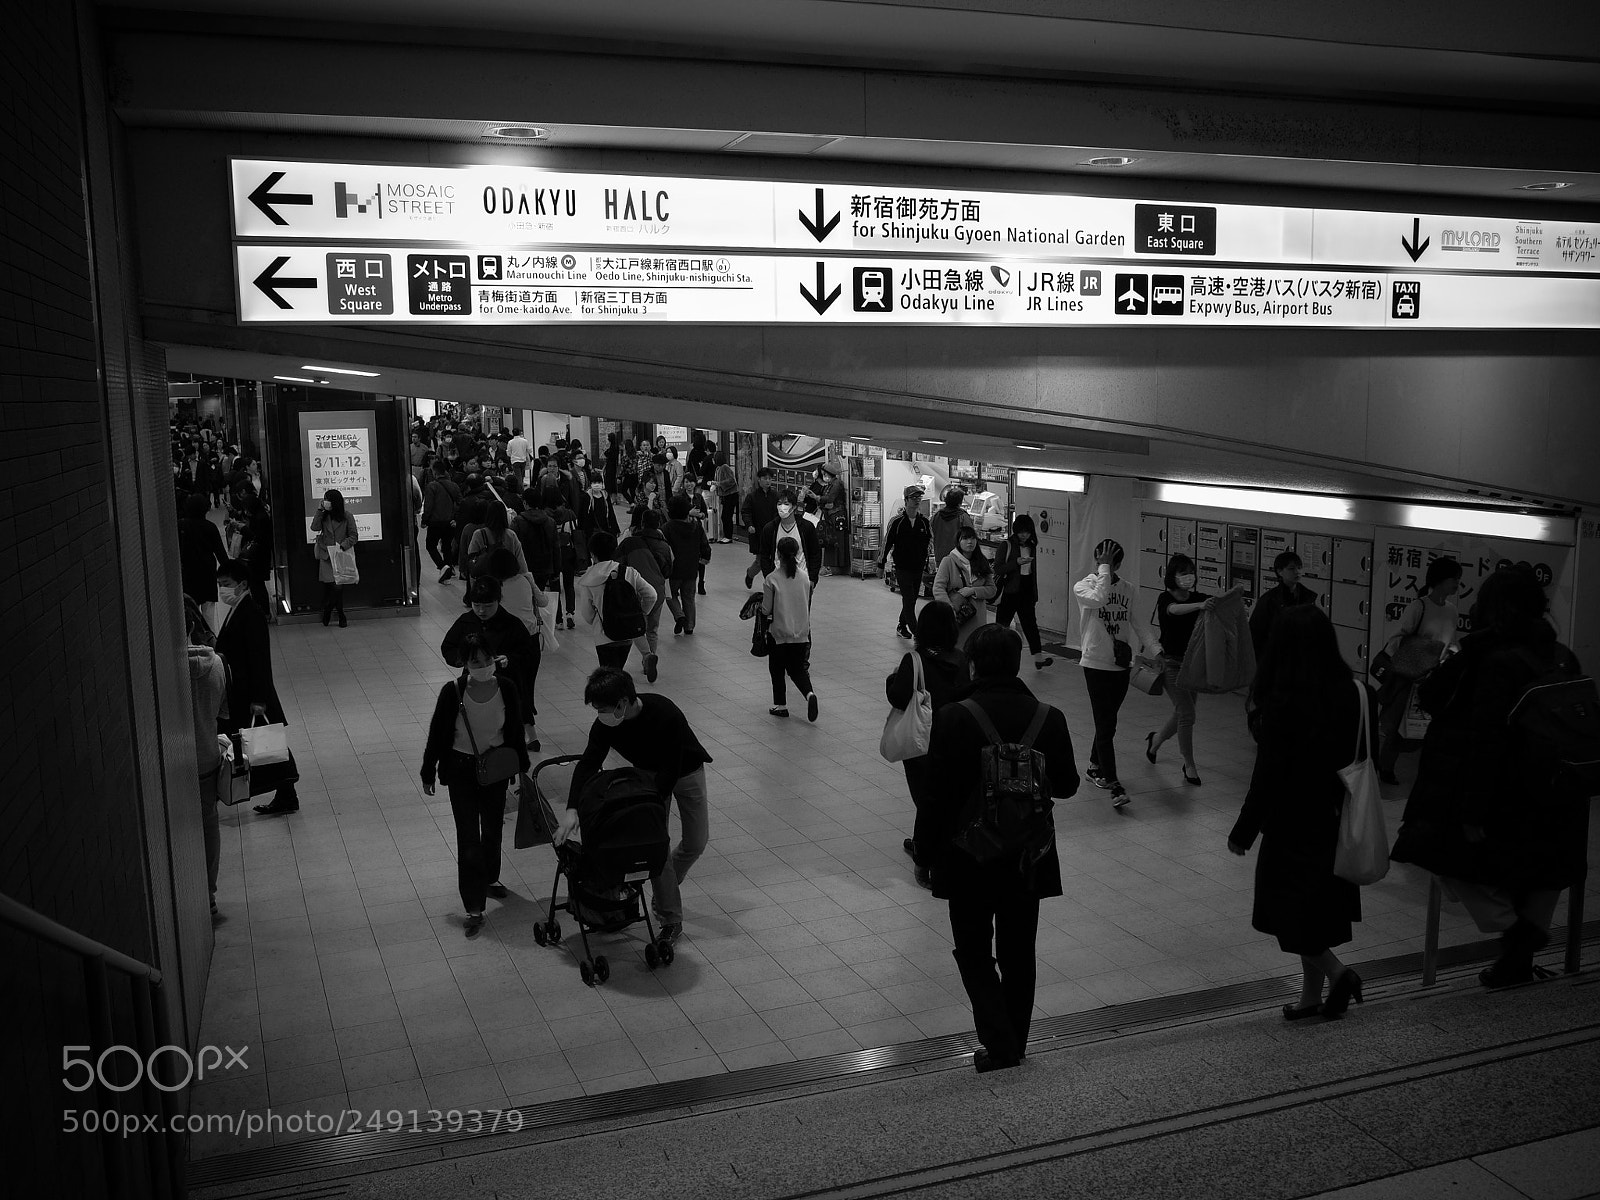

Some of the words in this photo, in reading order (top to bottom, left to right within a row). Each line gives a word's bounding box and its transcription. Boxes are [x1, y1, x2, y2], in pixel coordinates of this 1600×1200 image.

[388, 184, 454, 198] MOSAIC
[389, 200, 454, 214] STREET
[483, 185, 577, 217] ODAKYU
[605, 188, 669, 221] HALC
[851, 194, 980, 223] 新宿御苑方面
[1158, 213, 1194, 233] 東口
[853, 221, 875, 237] for
[881, 222, 949, 243] Shinjuku
[955, 226, 1000, 244] Gyoen
[1008, 228, 1068, 243] National
[1076, 231, 1124, 246] Garden
[1441, 230, 1501, 246] MYLORD
[1515, 236, 1543, 246] Southern
[1147, 235, 1170, 249] East
[1171, 238, 1204, 252] Square
[1516, 247, 1540, 255] Terrace
[336, 259, 383, 278] 西口
[414, 259, 467, 279] メトロ
[507, 256, 558, 270] 丸ノ内線
[602, 257, 713, 272] 大江戸線新宿西口駅
[507, 270, 564, 279] Marunouchi
[567, 271, 587, 281] Line
[596, 271, 619, 280] Oedo
[623, 272, 644, 281] Line,
[646, 272, 735, 285] Shinjuku-nishiguchi
[737, 274, 752, 282] Sta.
[901, 268, 983, 291] 小田急線
[1027, 272, 1074, 293] JR線
[345, 284, 376, 295] West
[428, 282, 451, 292] 通路
[1083, 277, 1098, 290] JR
[1394, 283, 1418, 294] TAXI
[429, 294, 452, 304] Metro
[478, 290, 557, 305] 青梅街道方面
[581, 291, 667, 306] 新宿三丁目方面
[901, 294, 957, 313] Odakyu
[965, 295, 994, 310] Line
[1027, 297, 1041, 310] JR
[1048, 295, 1084, 311] Lines
[340, 299, 382, 313] Square
[420, 302, 461, 312] Underpass
[480, 304, 493, 313] for
[497, 305, 549, 313] Ome-kaido
[552, 305, 572, 313] Ave.
[582, 305, 594, 313] for
[598, 305, 638, 316] Shinjuku
[643, 306, 646, 314] 3
[1190, 300, 1231, 317] Expwy
[1235, 301, 1259, 316] Bus,
[1263, 301, 1308, 318] Airport
[1313, 302, 1332, 315] Bus
